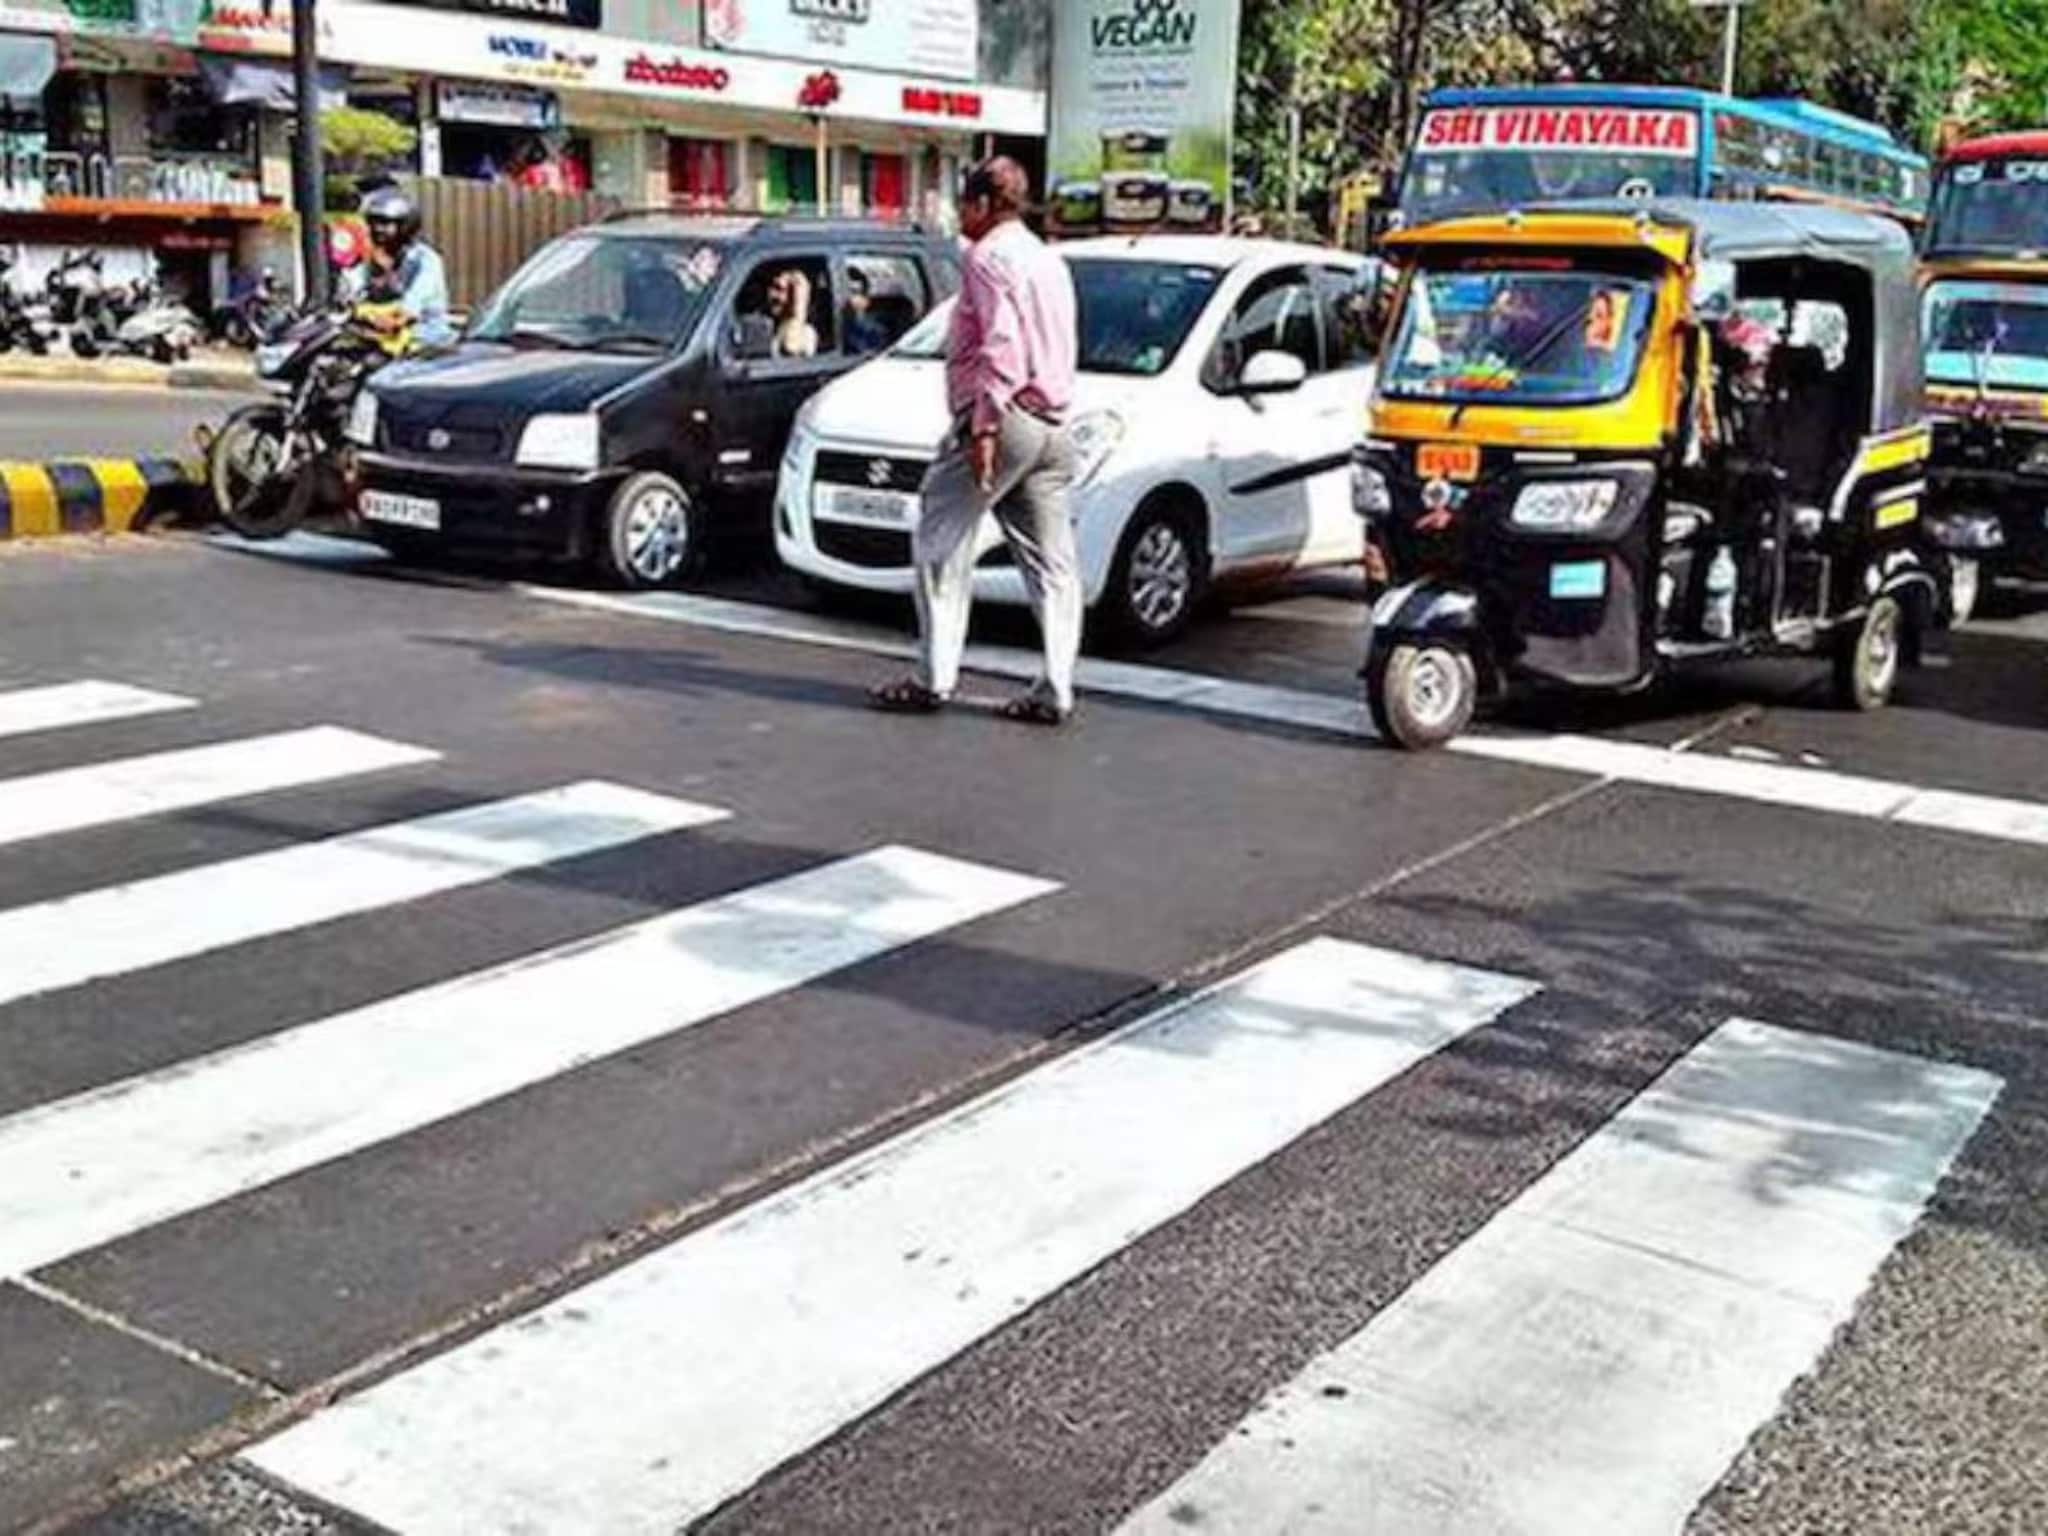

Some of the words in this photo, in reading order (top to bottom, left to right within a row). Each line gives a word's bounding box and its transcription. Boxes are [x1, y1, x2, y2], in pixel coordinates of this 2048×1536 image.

[1092, 12, 1195, 46] VEGAN
[1424, 108, 1485, 144] SRI
[1493, 109, 1688, 148] VINAYAKA
